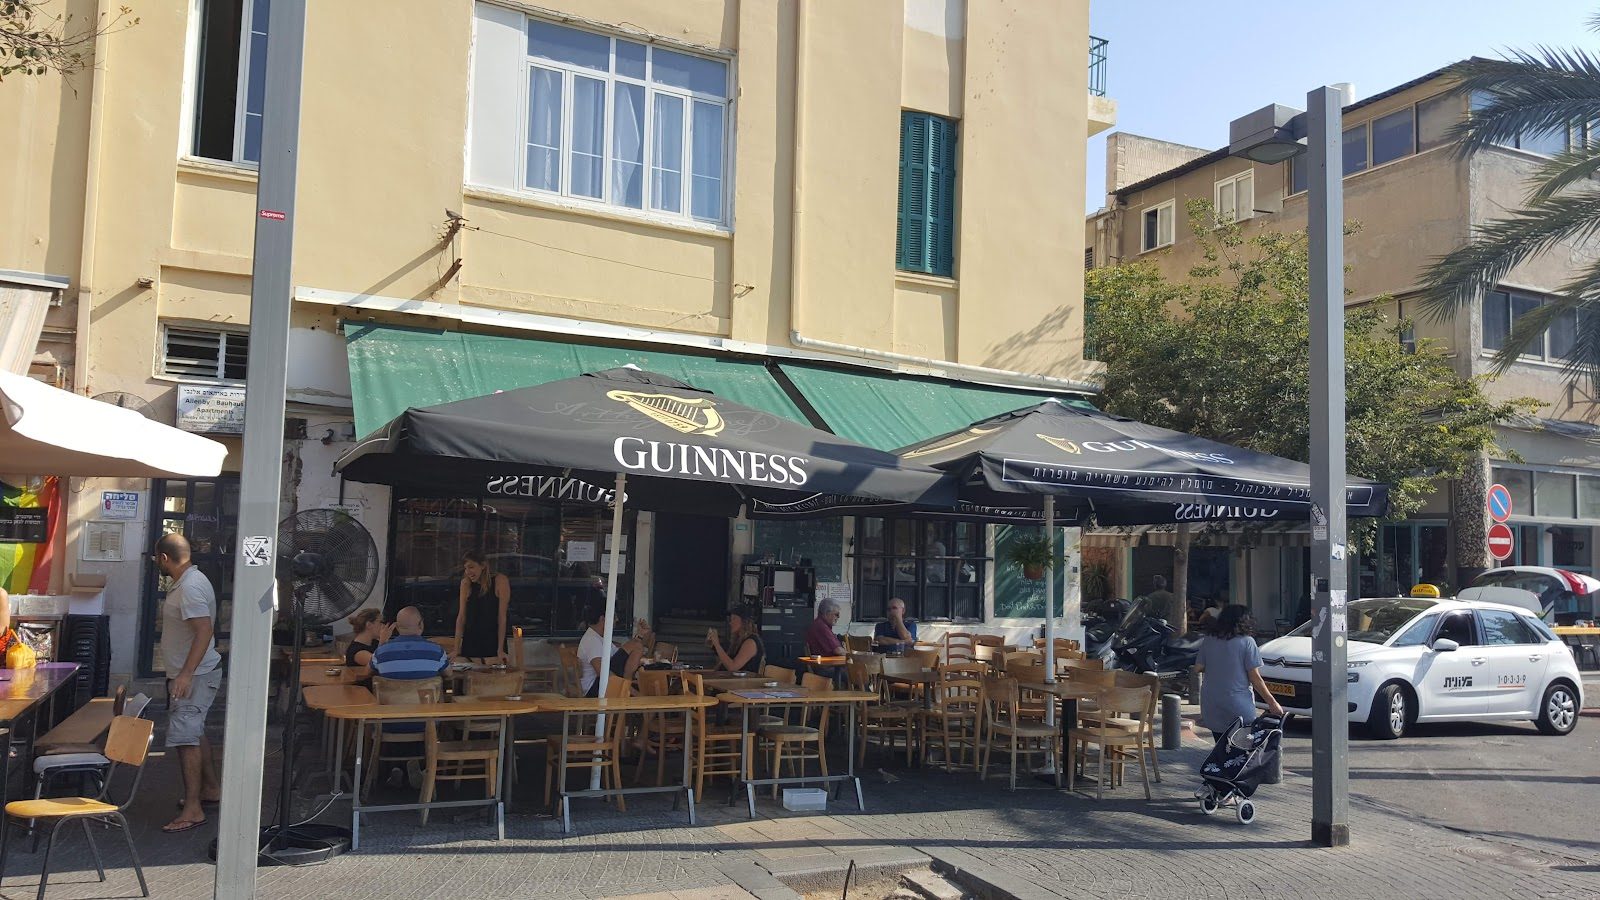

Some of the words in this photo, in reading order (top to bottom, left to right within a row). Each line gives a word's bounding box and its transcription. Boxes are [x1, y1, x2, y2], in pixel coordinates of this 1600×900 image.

[261, 210, 285, 219] Supreme
[185, 398, 211, 406] Allenby
[1082, 439, 1235, 465] GUIESS
[613, 437, 808, 486] GUINNESS
[1032, 467, 1077, 481] מופרזת
[1085, 471, 1129, 485] משתייה
[1135, 475, 1174, 488] להימנע
[1234, 481, 1280, 496] אלכוהול
